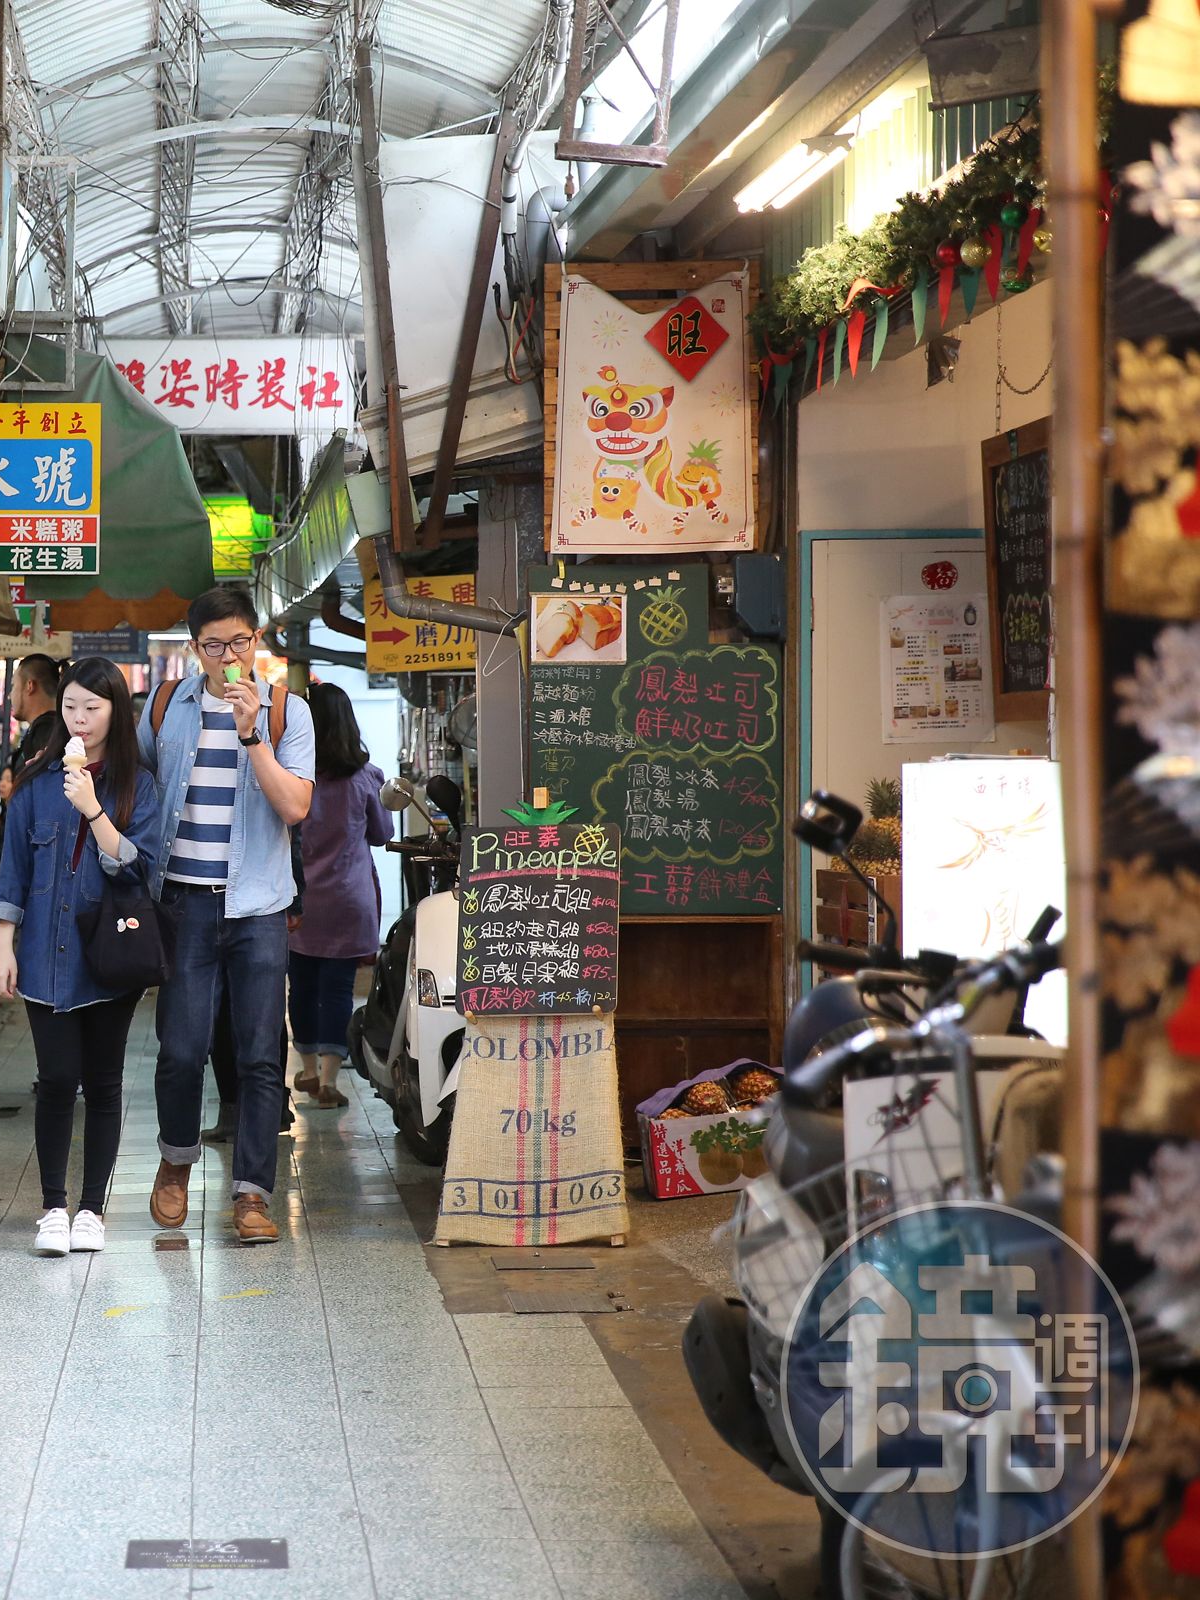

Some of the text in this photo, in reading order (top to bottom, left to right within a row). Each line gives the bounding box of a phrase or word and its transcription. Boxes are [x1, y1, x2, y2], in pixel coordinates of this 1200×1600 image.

[666, 311, 708, 357] 旺
[10, 518, 84, 542] 米糕粥
[10, 547, 84, 570] 花生湯
[405, 652, 461, 665] 2251891
[635, 706, 759, 743] 鮮奶吐司
[469, 832, 617, 881] Pineapple
[500, 1108, 577, 1137] 70 kg
[453, 1186, 467, 1208] 3
